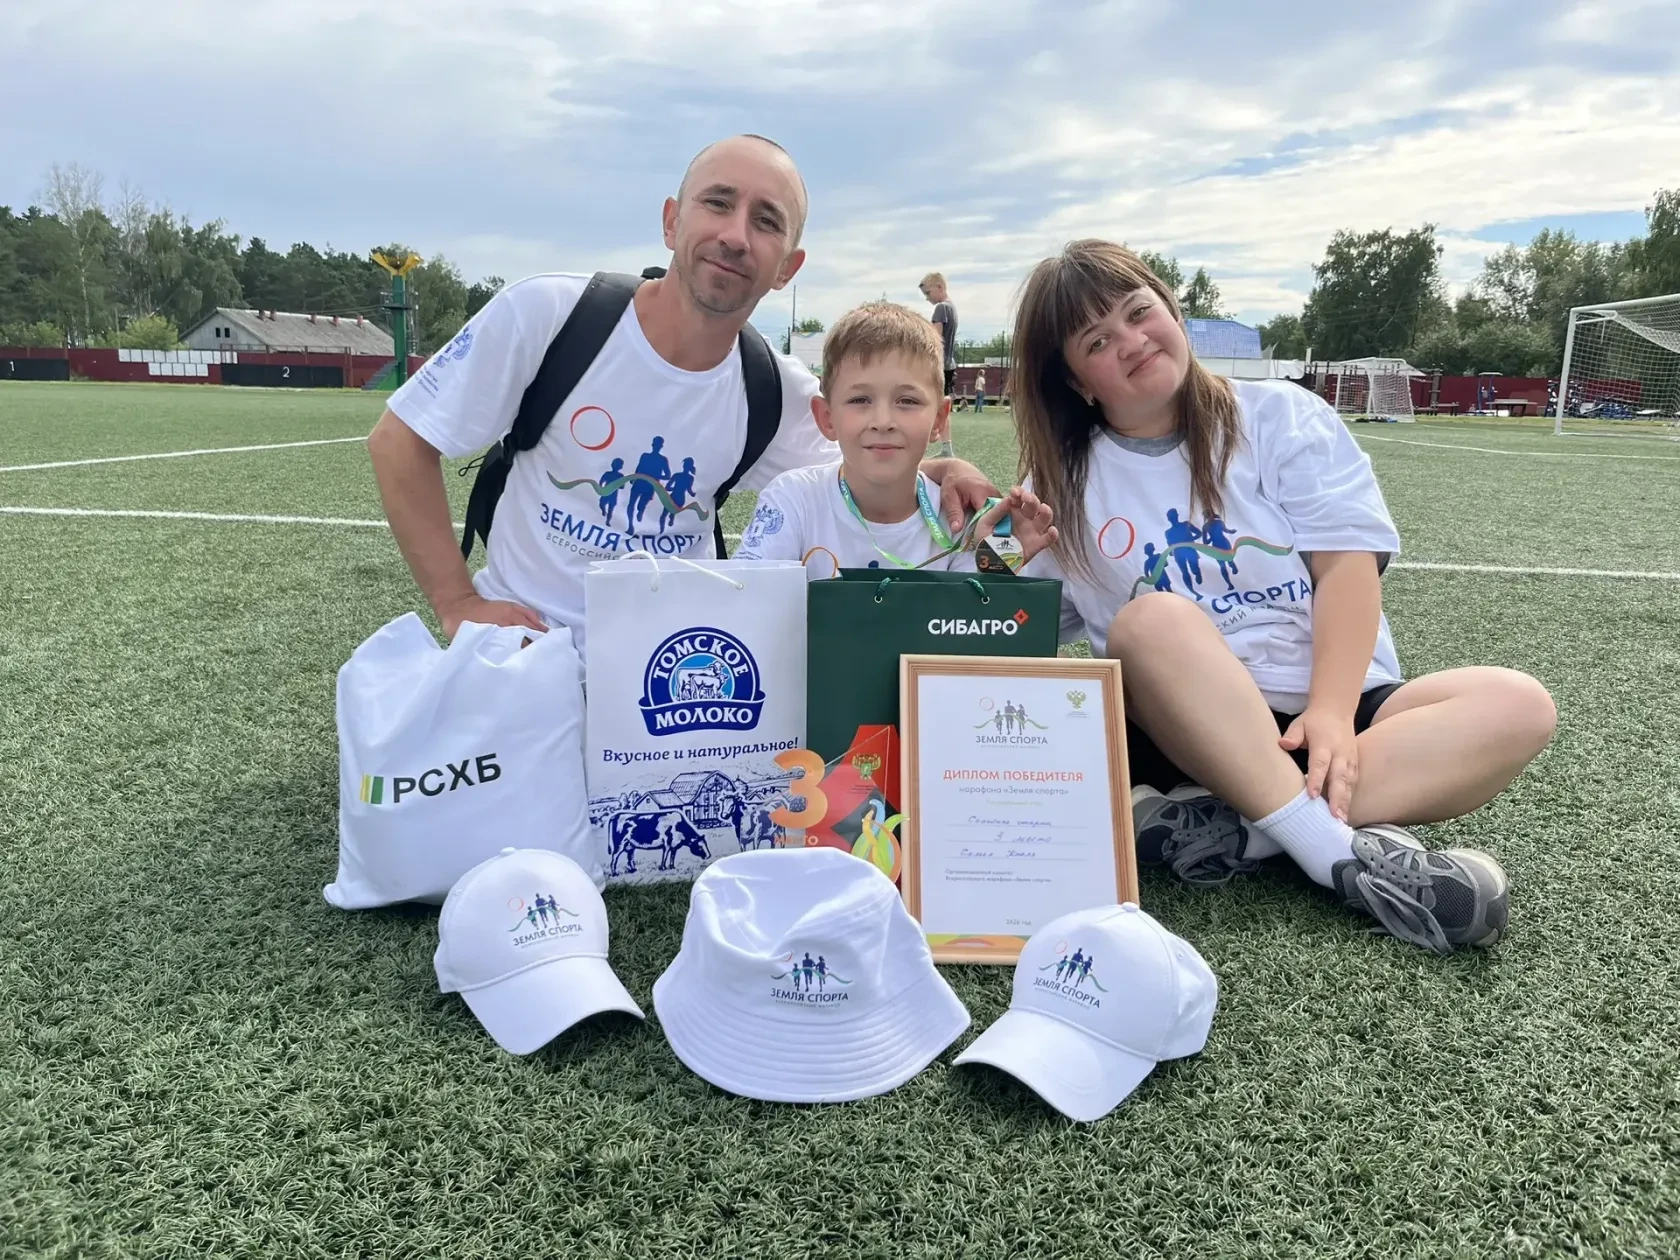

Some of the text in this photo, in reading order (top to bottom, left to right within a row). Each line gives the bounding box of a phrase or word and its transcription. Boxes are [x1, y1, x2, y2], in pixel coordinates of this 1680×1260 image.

[9, 360, 15, 372] 1
[282, 366, 290, 378] 2
[540, 503, 702, 555] ЗЕМЛЯ СПОРТ
[1211, 577, 1312, 614] СПОРТА
[927, 618, 1018, 636] СИБАГРО
[653, 635, 749, 680] ТОМСКОЕ
[655, 707, 753, 730] МОЛОКО
[975, 735, 1048, 744] ЗЕМЛЯ СПОРТА
[603, 737, 799, 765] Вкусное и натуральное!
[393, 753, 502, 803] РСХБ
[943, 769, 1084, 782] ДИПЛОМ ПОБЕДИТЕЛЯ
[768, 749, 828, 829] 3
[959, 785, 1069, 796] марафона «Земля спорта»
[512, 930, 547, 946] ЗЕМЛЯ
[548, 924, 584, 936] СПОРТА
[770, 988, 849, 1003] ЗЕМЛЯ СПОРТА
[1033, 977, 1061, 991] ЗЕМЛЯ
[1062, 985, 1100, 1008] СПОРТА
